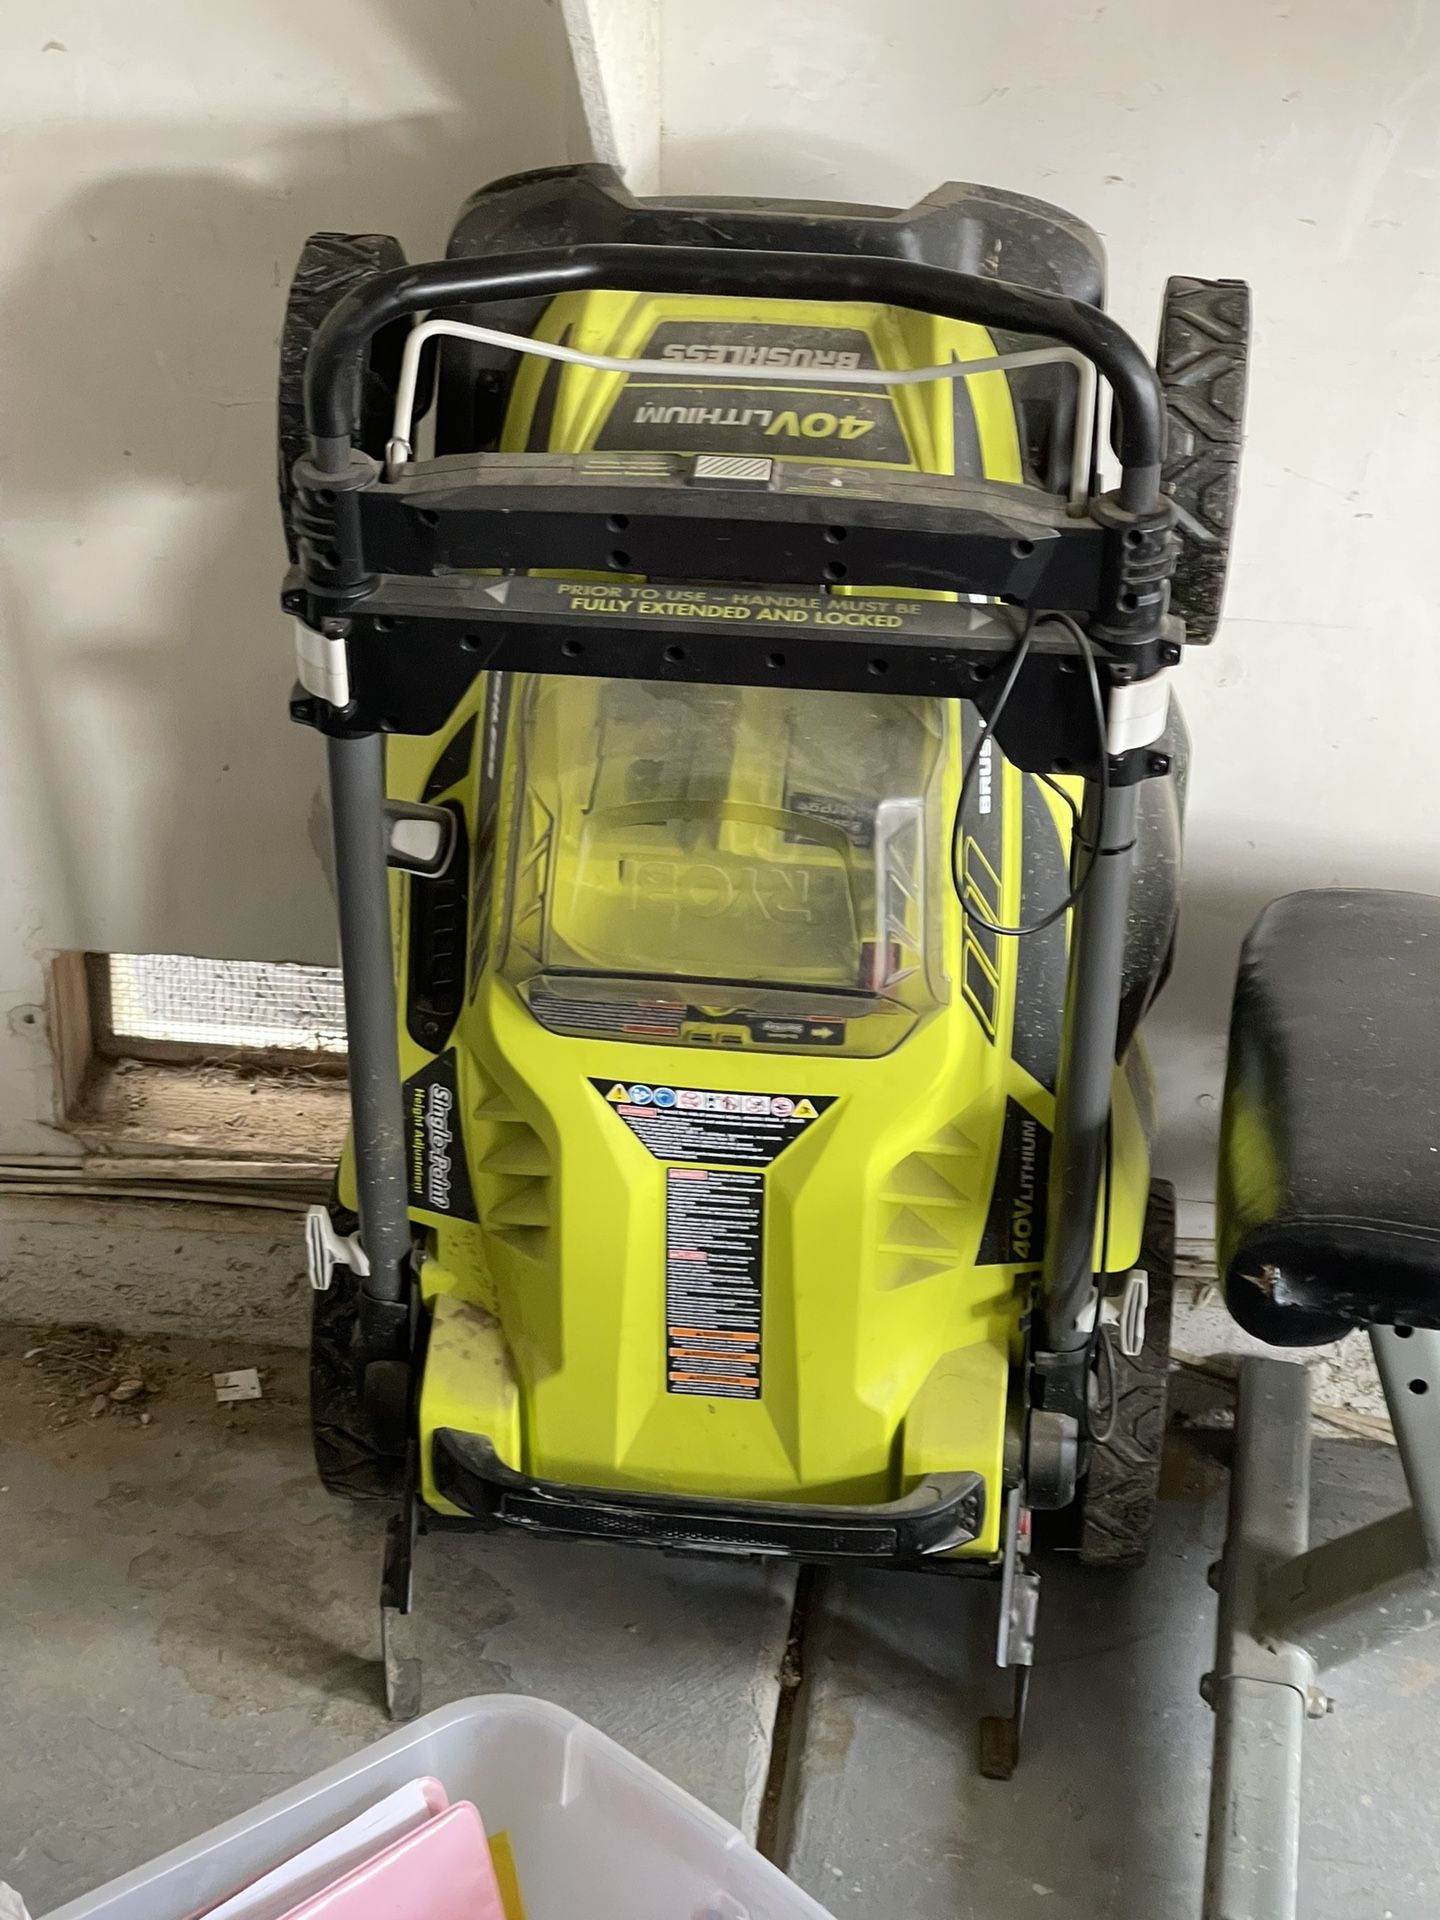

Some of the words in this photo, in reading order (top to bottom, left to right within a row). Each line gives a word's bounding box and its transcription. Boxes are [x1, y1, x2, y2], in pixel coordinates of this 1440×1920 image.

[661, 343, 861, 369] BRUSHLESS
[557, 584, 623, 598] PRIOR
[629, 588, 660, 600] TO
[665, 590, 707, 603] USE
[731, 593, 822, 610] HANDLE
[827, 599, 890, 614] MUST
[895, 603, 922, 615] BE
[570, 597, 633, 613] FULLY
[637, 601, 751, 619] EXTENDED
[756, 607, 809, 623] AND
[814, 611, 903, 628] LOCKED
[411, 1087, 426, 1127] Height
[410, 1130, 426, 1195] Adjustment
